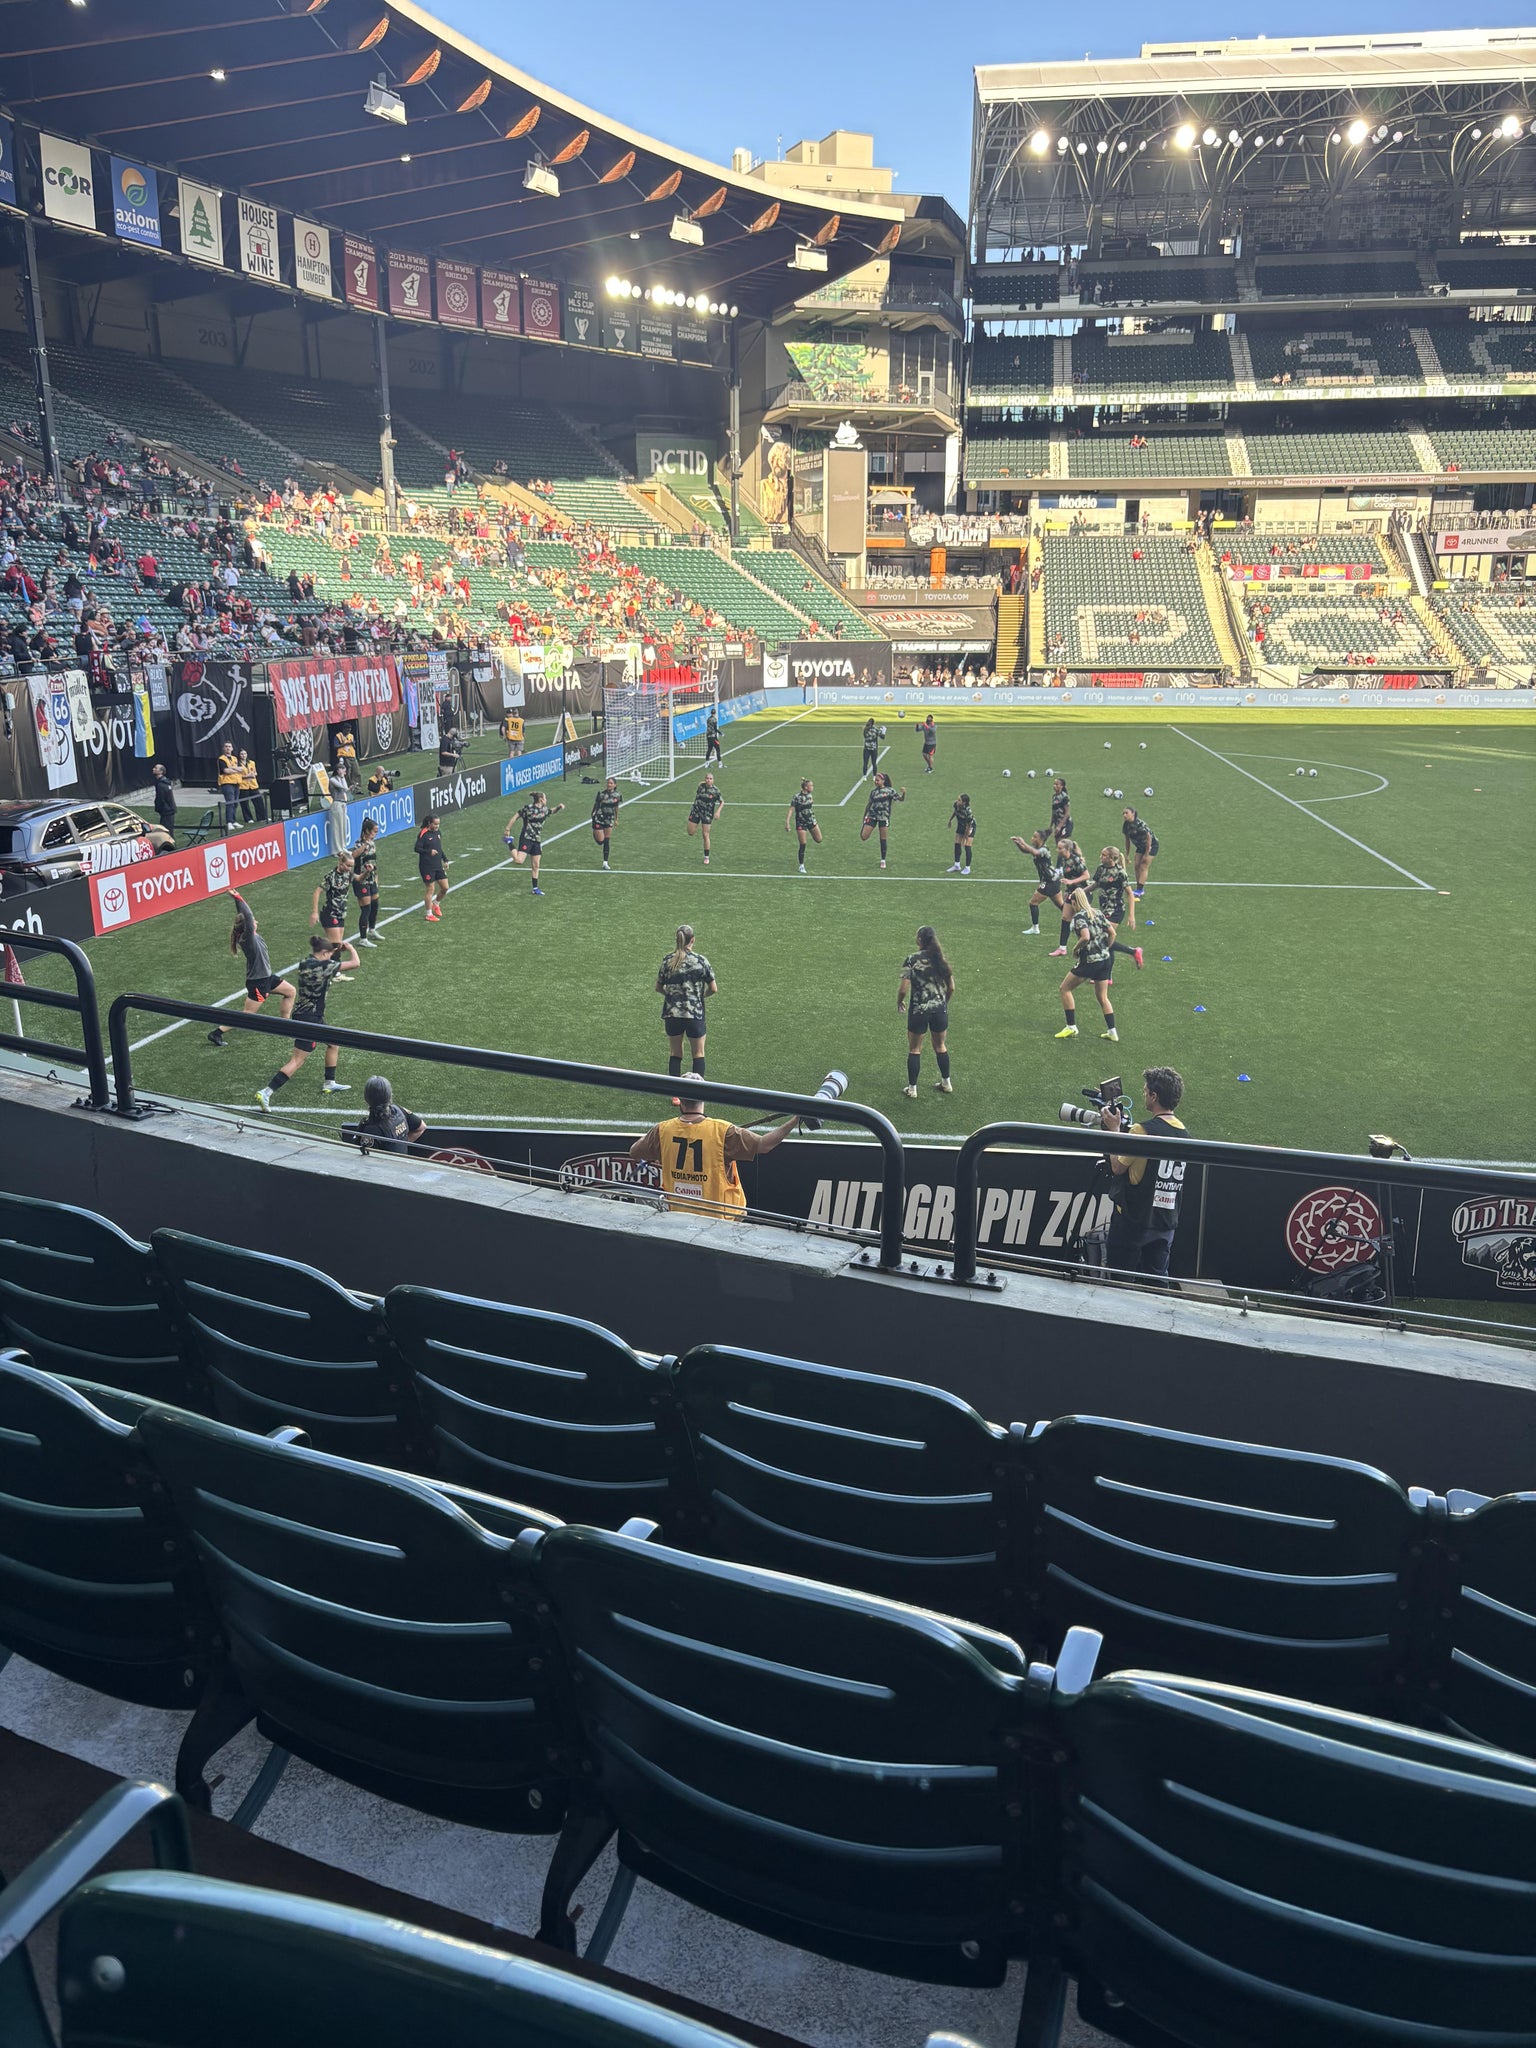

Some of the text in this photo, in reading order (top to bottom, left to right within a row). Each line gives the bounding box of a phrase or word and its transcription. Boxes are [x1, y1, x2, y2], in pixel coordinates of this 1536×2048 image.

[115, 208, 159, 231] axiom
[241, 202, 275, 229] HOUSE
[116, 223, 140, 235] eco-pest
[309, 239, 316, 251] H
[358, 243, 375, 254] NWSL
[345, 247, 376, 262] CHAMPIONS
[389, 252, 429, 265] 2013 NWSL
[247, 253, 275, 277] WINE
[297, 256, 330, 276] HAMPTON
[389, 261, 429, 273] CHAMPIONS
[437, 261, 475, 275] 2016 NWSL
[302, 270, 326, 285] LUMBER
[445, 271, 468, 280] SHIELD
[482, 270, 518, 283] 2017 NWSL
[482, 280, 518, 290] CHAMPIONS
[531, 287, 552, 296] SHIELD
[539, 281, 558, 290] NWSL
[574, 291, 589, 300] 2015
[568, 298, 594, 309] MLS CUP
[568, 307, 595, 315] CHAMPIONS
[641, 325, 672, 337] CHAMPIONS
[677, 333, 707, 342] CHAMPIONS
[641, 346, 672, 356] CHAMPIONS
[978, 395, 1001, 406] RING
[1007, 395, 1040, 406] HONOR
[1107, 394, 1137, 405] CLIVE
[1138, 392, 1188, 404] CHARLES
[1195, 392, 1228, 402] JIMMY
[1230, 391, 1275, 402] CONWAY
[1425, 386, 1459, 397] DIEGO
[1463, 385, 1502, 396] VALERI
[650, 449, 708, 476] RCTID
[1059, 495, 1098, 509] Modelo
[952, 526, 988, 542] TRAPPER
[1461, 537, 1499, 545] 4RUNNER
[924, 593, 969, 601] TOYOTA.COM
[792, 659, 854, 678] TOYOTA
[528, 670, 582, 693] TOYOTA
[280, 676, 310, 718] ROSE
[309, 673, 334, 712] CITY
[348, 668, 392, 706] RIVETERS
[818, 690, 838, 702] ring
[905, 690, 925, 702] ring
[993, 691, 1013, 703] ring
[1083, 692, 1104, 704] ring
[1175, 692, 1196, 703] ring
[1268, 692, 1289, 704] ring
[1362, 694, 1383, 705] ring
[1459, 694, 1480, 705] ring
[53, 697, 67, 720] 66
[510, 721, 519, 729] 76
[82, 717, 134, 757] OYOT
[516, 770, 532, 785] KAISER
[430, 774, 487, 810] First Tech
[289, 822, 320, 857] ring
[390, 794, 413, 824] ring
[78, 839, 139, 876] THORNS
[231, 840, 282, 871] TOYOTA
[57, 867, 73, 875] TOYOTA
[131, 867, 195, 903] TOYOTA
[0, 906, 44, 936] ch
[672, 1136, 703, 1173] 71
[560, 1157, 663, 1189] OLD TRAPP
[674, 1185, 702, 1197] Canon
[805, 1179, 1037, 1245] AUTGRPH
[1454, 1206, 1497, 1234] OLD
